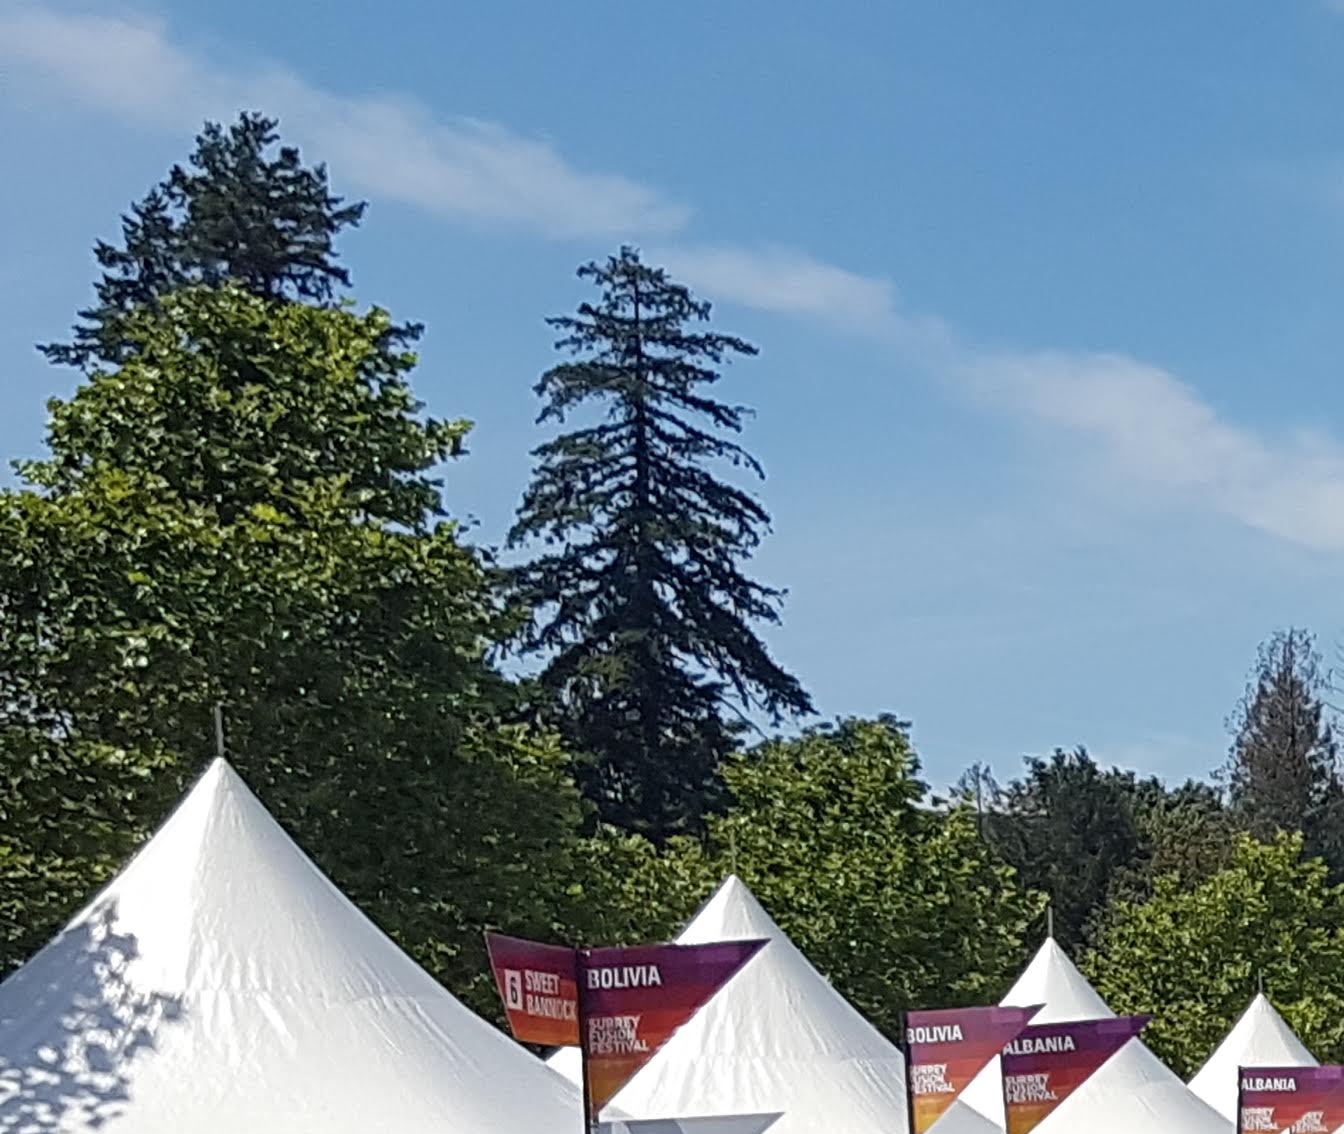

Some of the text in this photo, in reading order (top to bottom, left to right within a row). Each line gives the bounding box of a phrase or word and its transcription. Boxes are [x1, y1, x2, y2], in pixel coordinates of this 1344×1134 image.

[524, 969, 560, 995] SWEET
[587, 965, 662, 990] BOLIVIA
[526, 995, 578, 1020] BANNOCK
[588, 1015, 641, 1031] SURREY
[588, 1028, 637, 1043] FUSION
[589, 1039, 650, 1056] FESTIVAL
[1002, 1036, 1075, 1056] ALBANIA
[1241, 1077, 1297, 1091] ALBANIA
